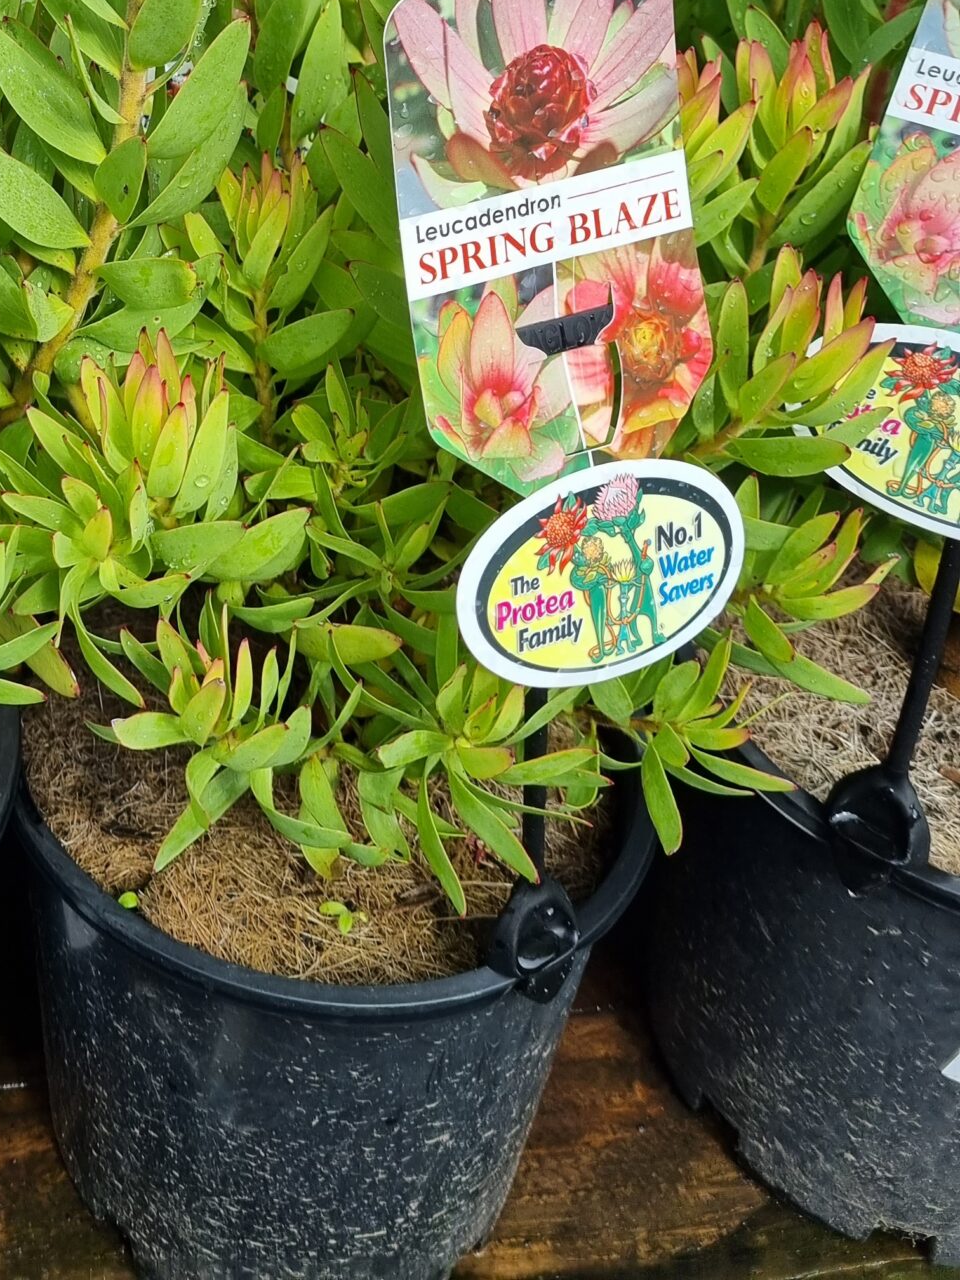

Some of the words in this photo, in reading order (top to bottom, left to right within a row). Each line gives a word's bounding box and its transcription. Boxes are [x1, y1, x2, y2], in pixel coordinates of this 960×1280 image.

[416, 194, 561, 244] Leucadendron
[418, 221, 555, 285] SPRING
[568, 188, 682, 245] BLAZE
[656, 512, 702, 552] No.1
[659, 546, 715, 579] Water
[511, 575, 540, 596] The
[659, 572, 715, 606] Savers
[496, 590, 575, 631] Protea
[518, 615, 583, 652] Family
